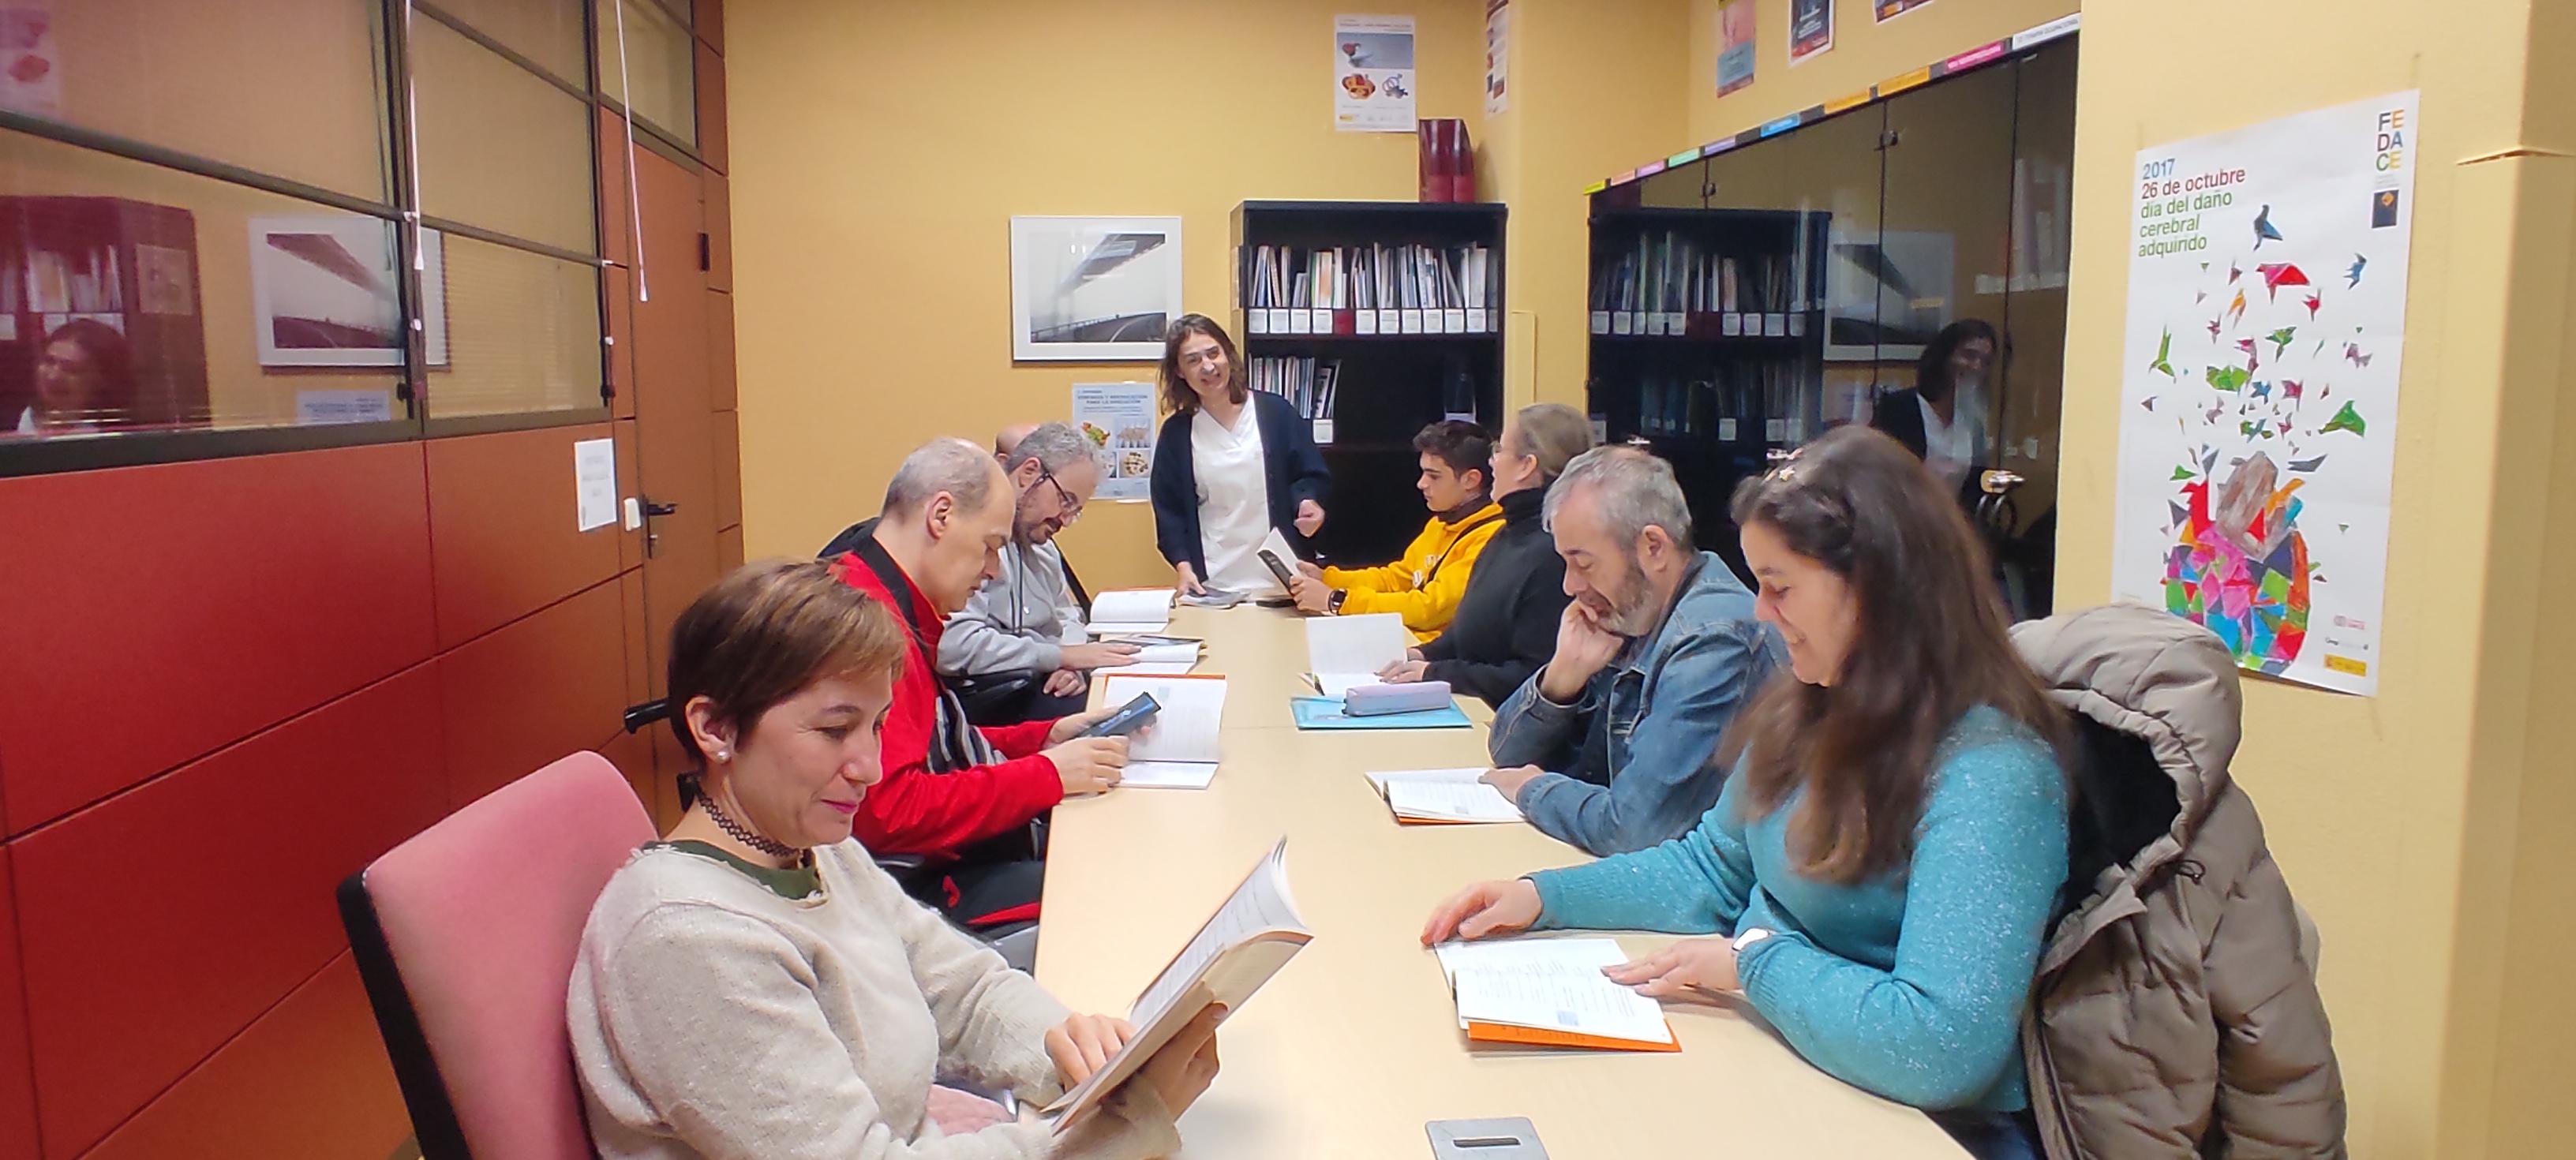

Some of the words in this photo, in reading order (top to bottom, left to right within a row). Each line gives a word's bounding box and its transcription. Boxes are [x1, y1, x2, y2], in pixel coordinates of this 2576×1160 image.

[2142, 158, 2176, 180] 2017
[2141, 181, 2159, 200] 26
[2162, 179, 2181, 196] de
[2185, 168, 2246, 193] octubre
[2166, 195, 2189, 215] del
[2193, 189, 2233, 211] daño
[2140, 213, 2201, 238] cerebral
[2138, 233, 2207, 259] adquirido
